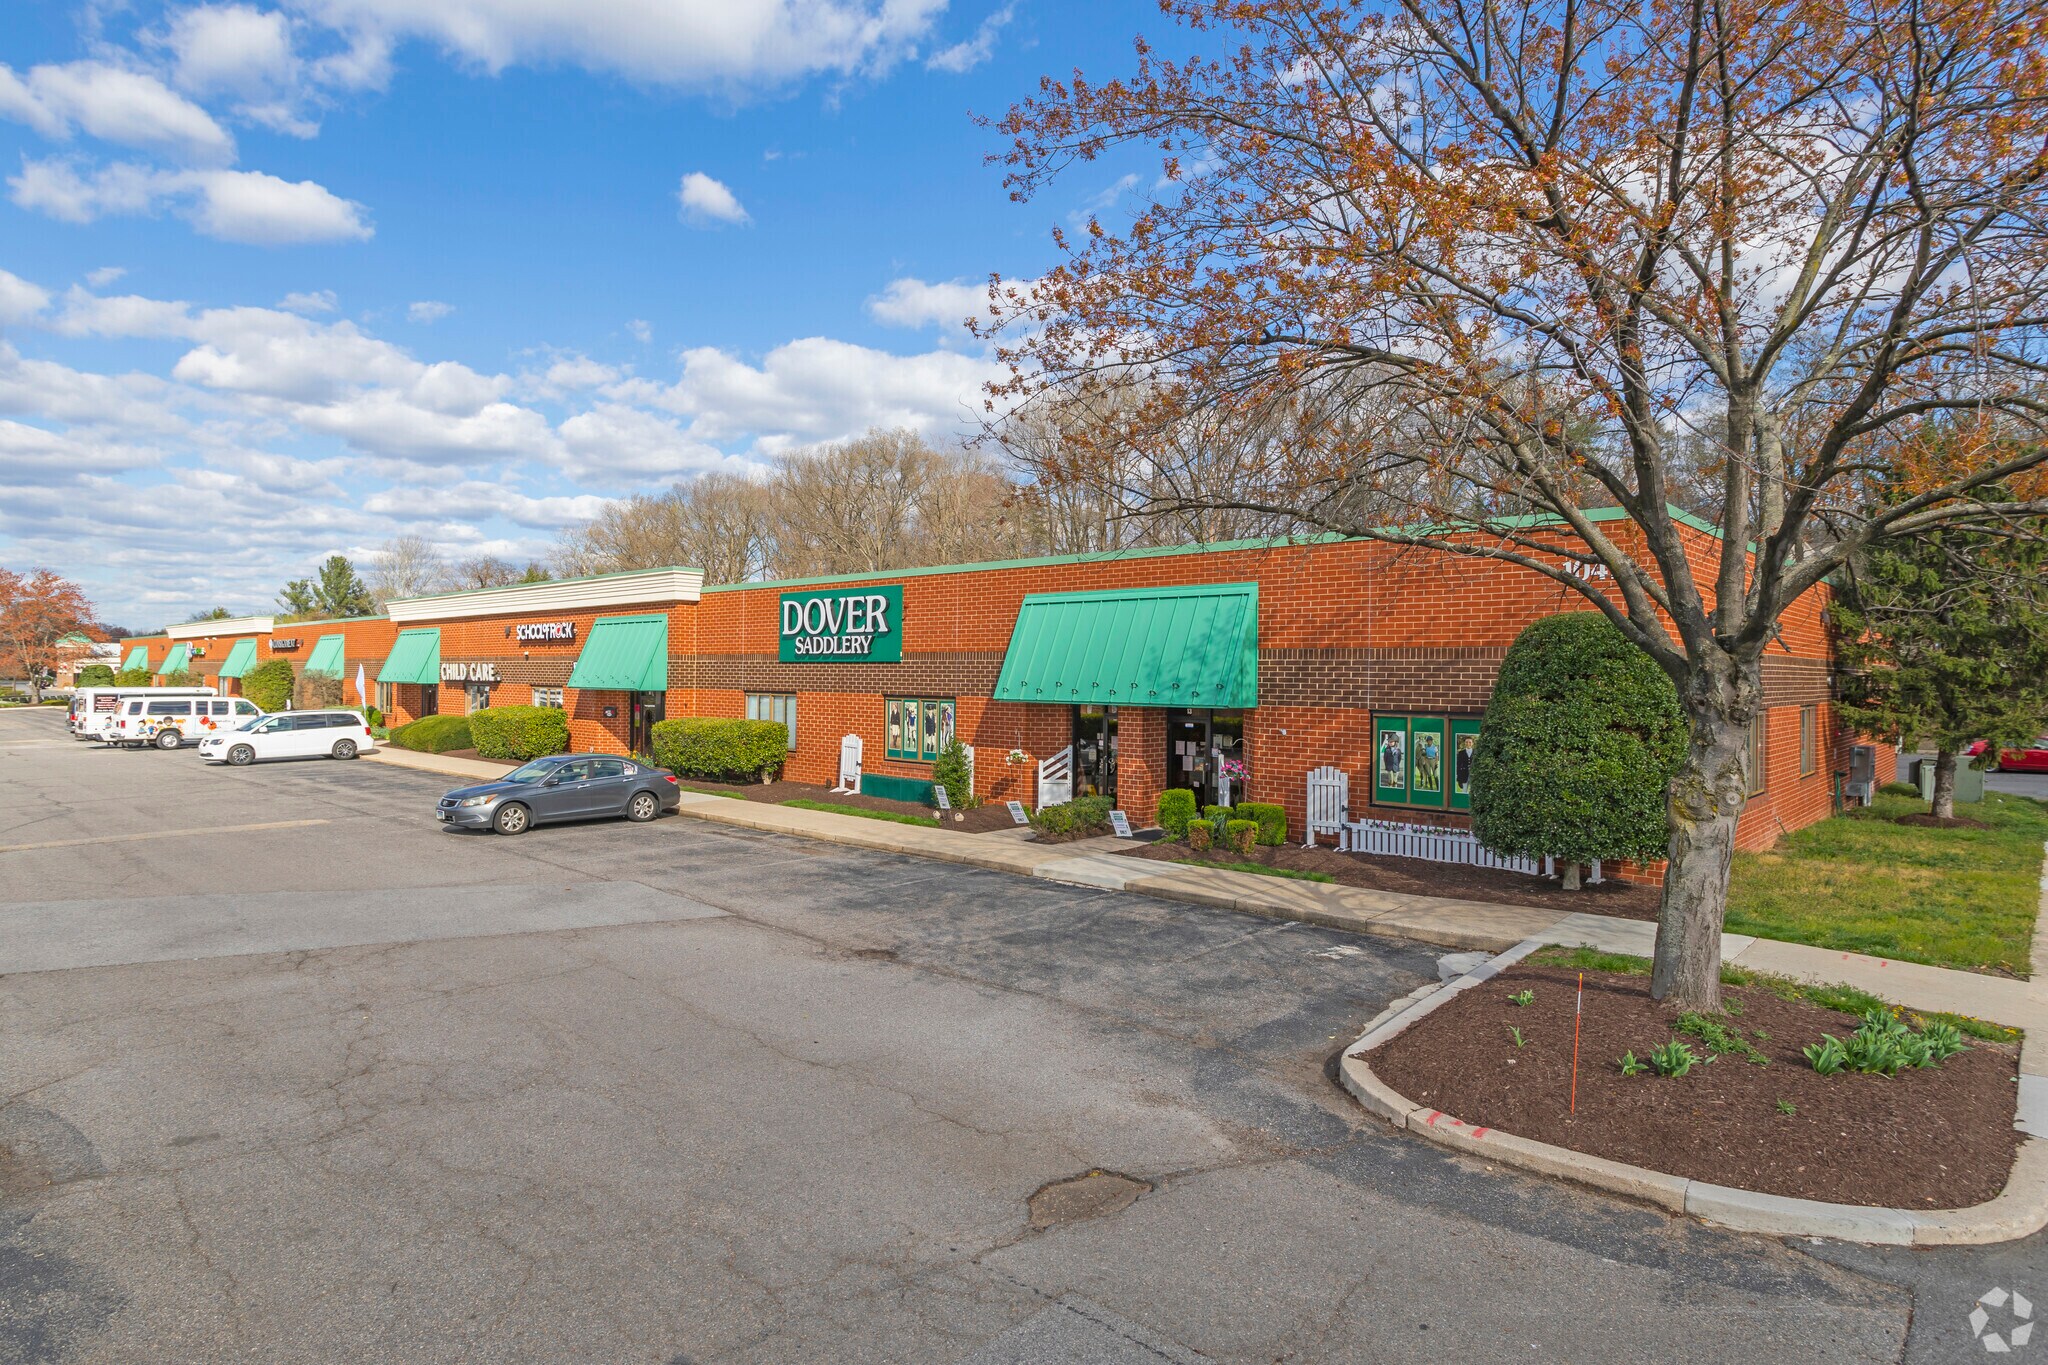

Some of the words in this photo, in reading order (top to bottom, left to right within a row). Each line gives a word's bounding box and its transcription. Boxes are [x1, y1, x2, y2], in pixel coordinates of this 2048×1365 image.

[782, 595, 889, 636] DOVER
[516, 623, 544, 640] SCHOOL
[549, 622, 573, 639] ROCK
[794, 635, 873, 655] SADDLERY
[441, 663, 467, 681] CHILD
[470, 662, 495, 681] CARE
